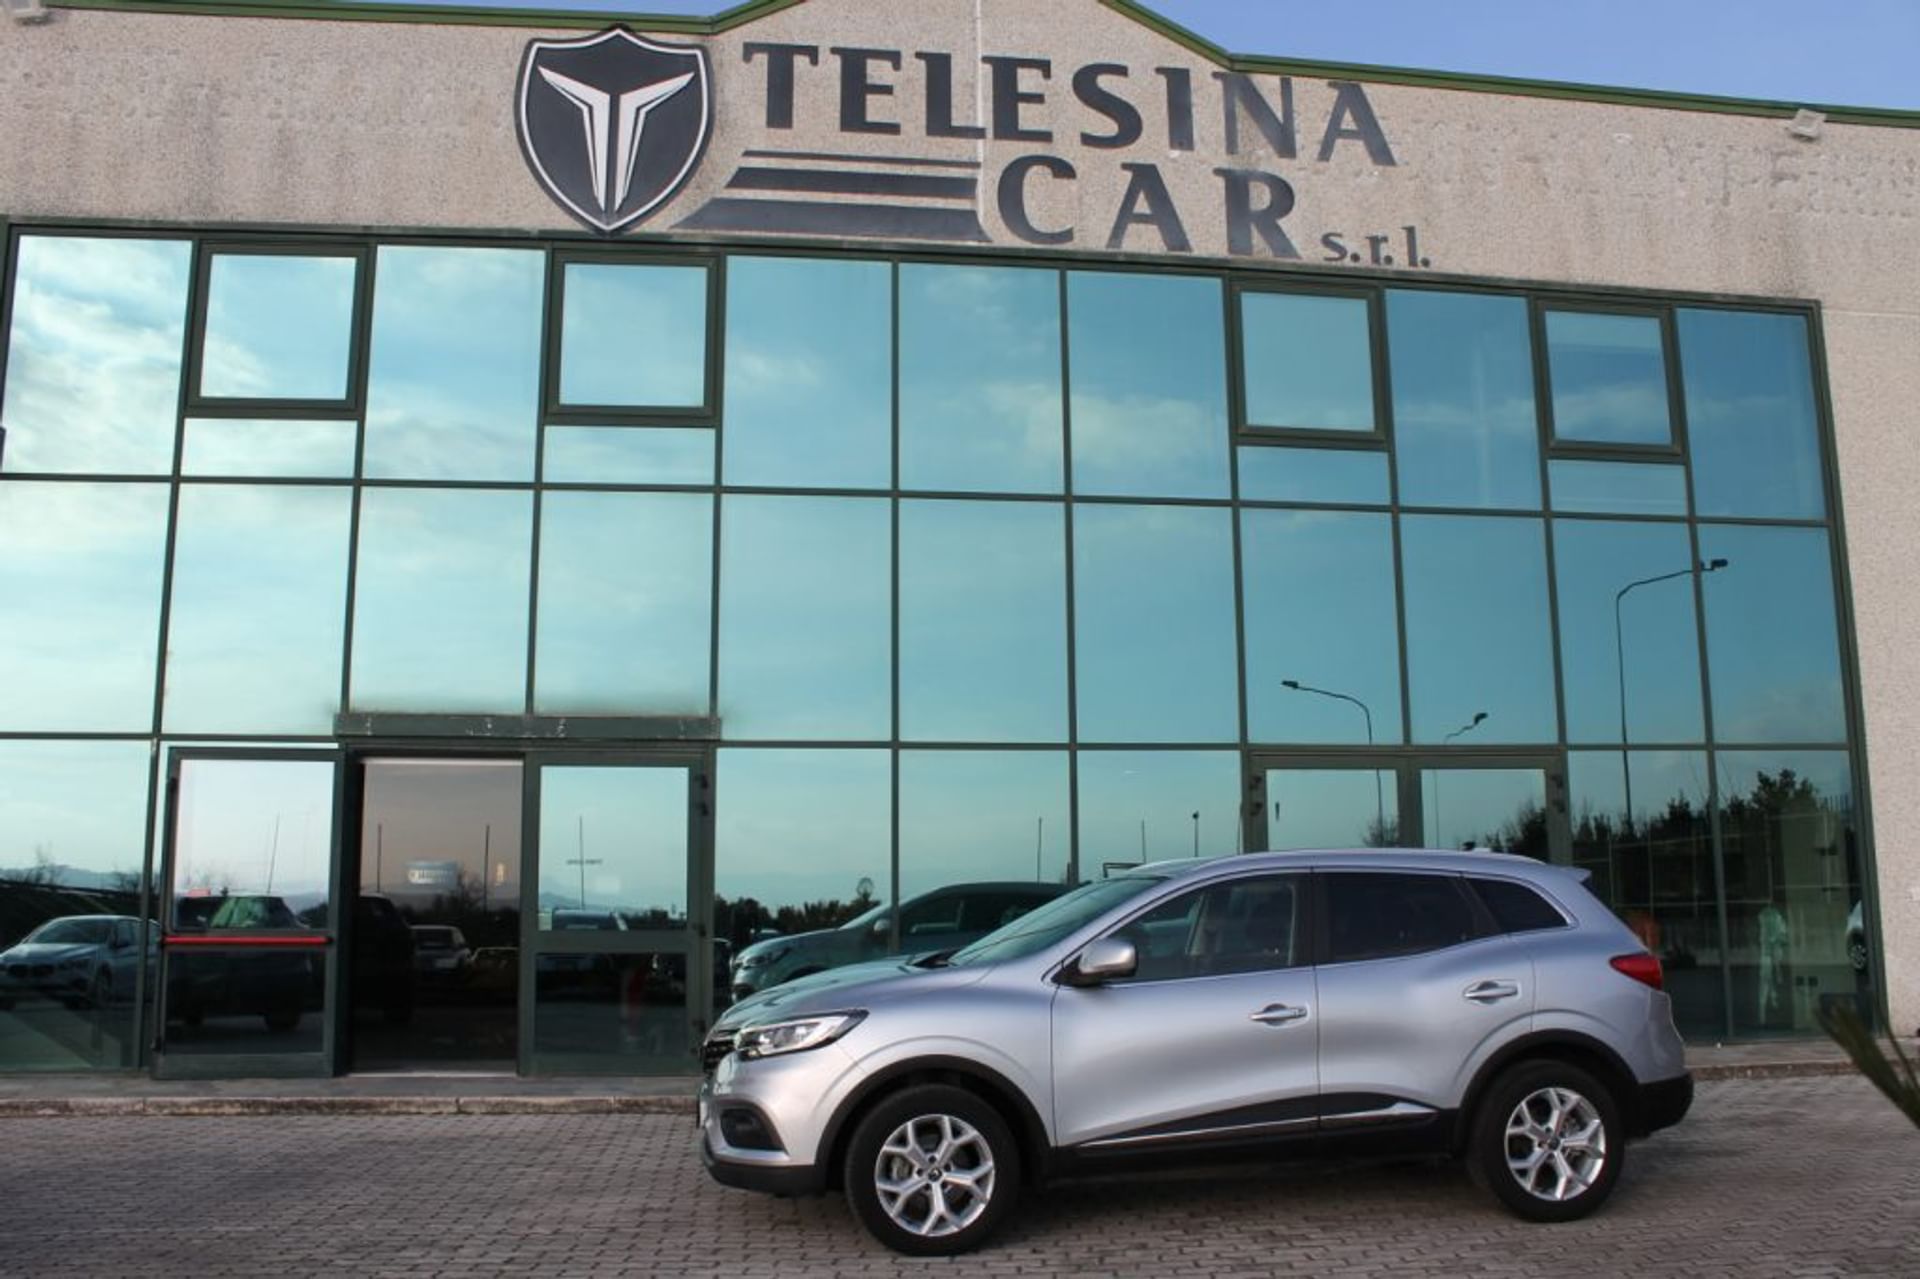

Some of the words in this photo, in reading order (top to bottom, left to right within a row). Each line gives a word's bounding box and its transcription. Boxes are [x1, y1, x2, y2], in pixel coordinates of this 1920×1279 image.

[743, 42, 1397, 166] TELESINA
[997, 154, 1303, 260] CAR
[1322, 225, 1431, 268] s.r.l.
